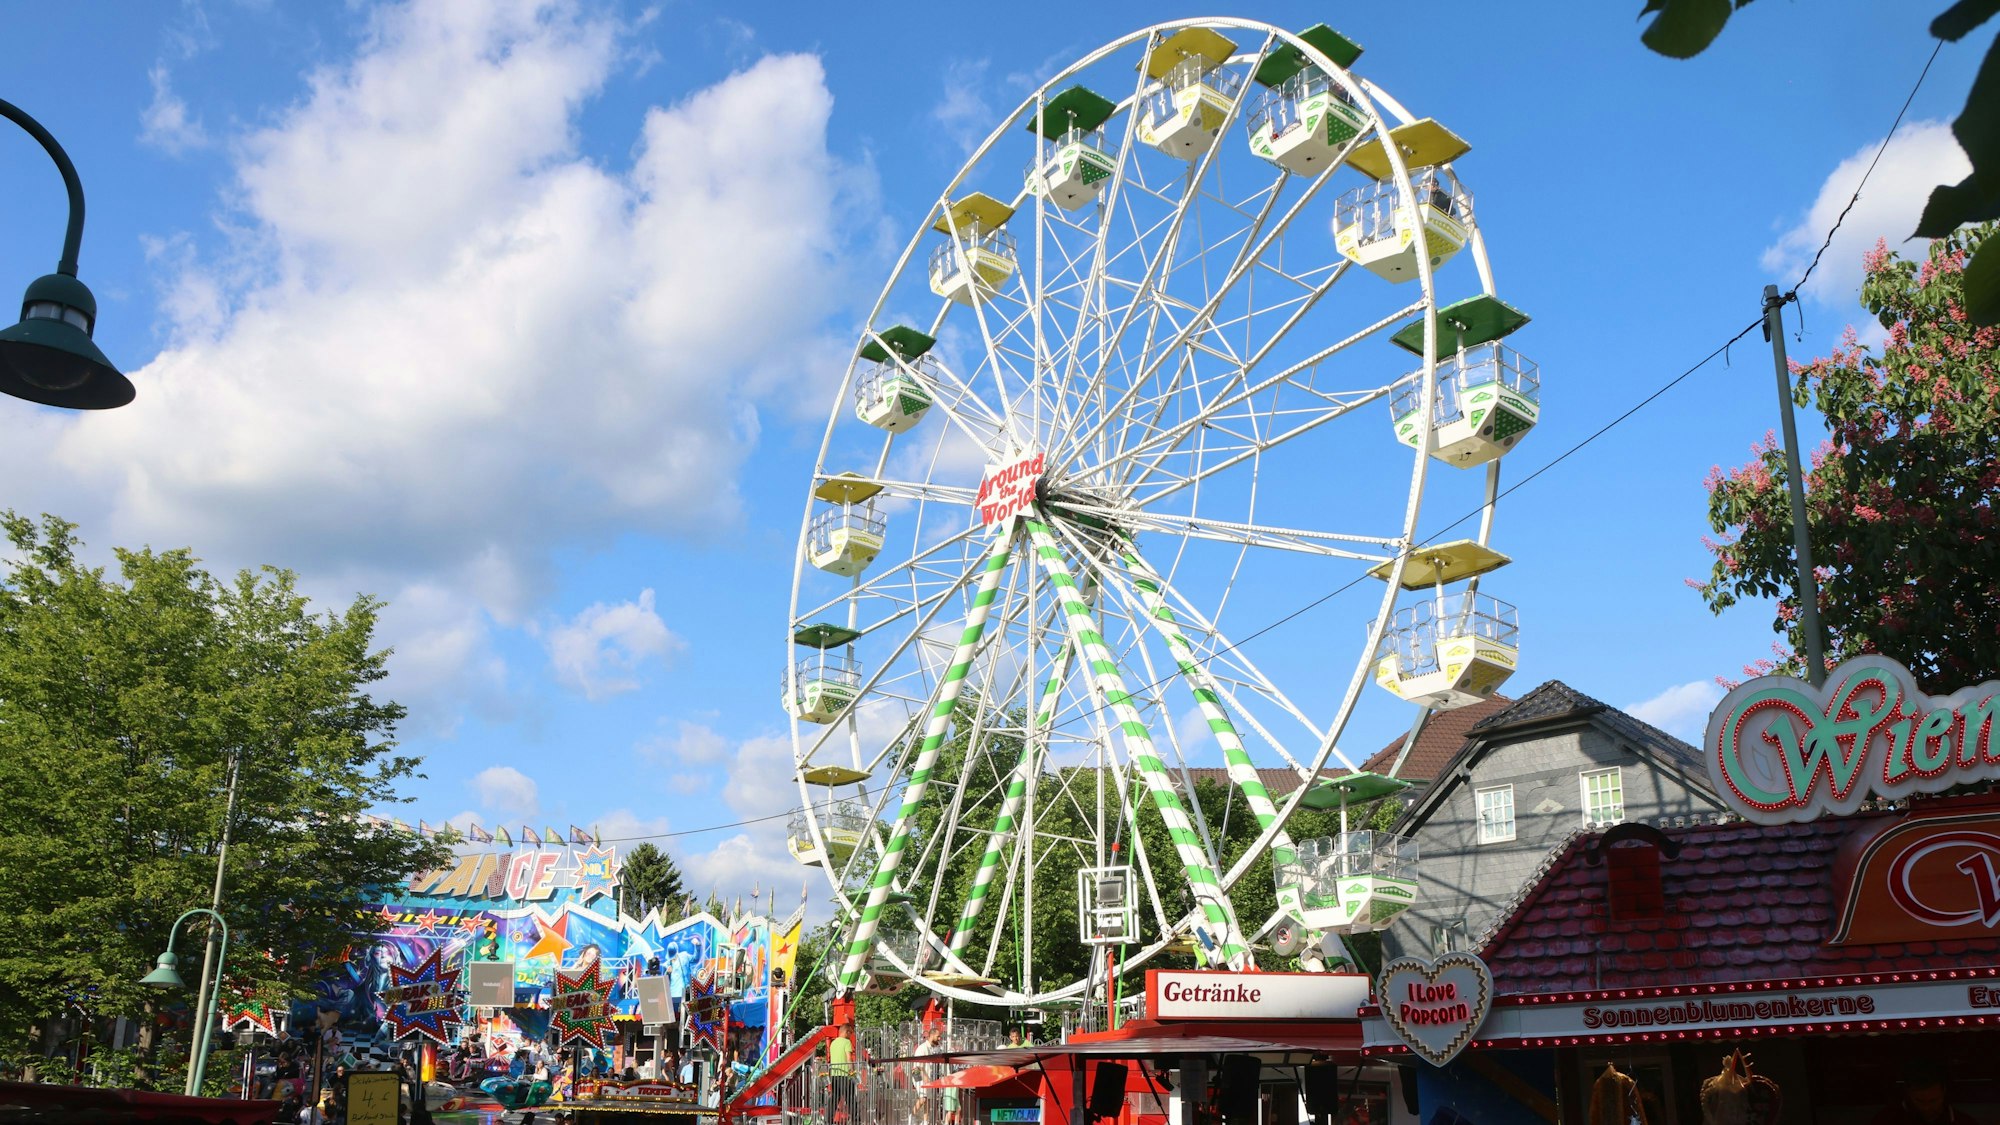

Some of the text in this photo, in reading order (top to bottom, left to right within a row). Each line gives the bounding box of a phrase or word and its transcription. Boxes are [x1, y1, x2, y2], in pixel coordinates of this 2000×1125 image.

[975, 453, 1044, 509] Around
[1000, 484, 1016, 499] the
[981, 477, 1037, 525] World
[1164, 981, 1261, 1003] Getränke
[1417, 983, 1455, 1003] Love
[1401, 1003, 1467, 1025] Popcorn
[1583, 994, 1875, 1028] Sonnenblumenkerne
